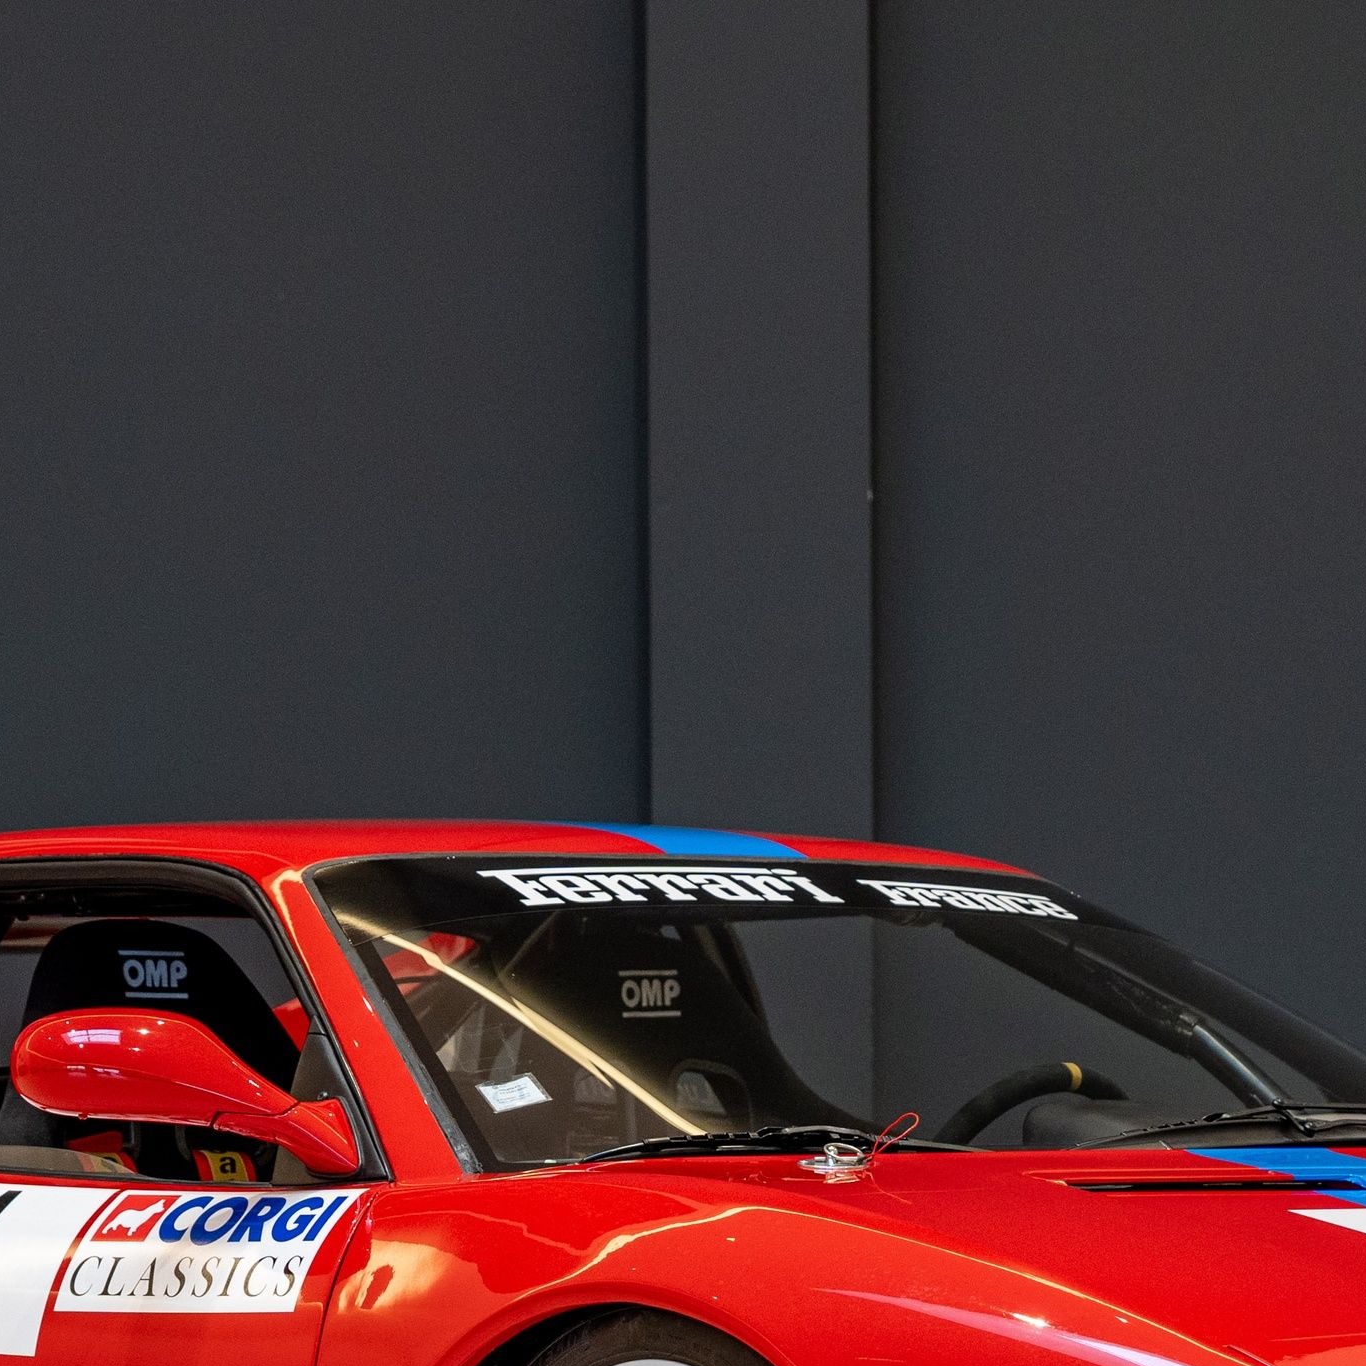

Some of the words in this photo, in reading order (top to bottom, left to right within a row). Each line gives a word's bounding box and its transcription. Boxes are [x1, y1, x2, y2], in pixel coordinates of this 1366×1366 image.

[475, 866, 845, 907] Ferrari
[855, 878, 1079, 921] France
[122, 959, 188, 988] OMP
[621, 979, 681, 1008] OMP
[158, 1195, 349, 1246] CORGI
[69, 1255, 304, 1299] CLASSICS
